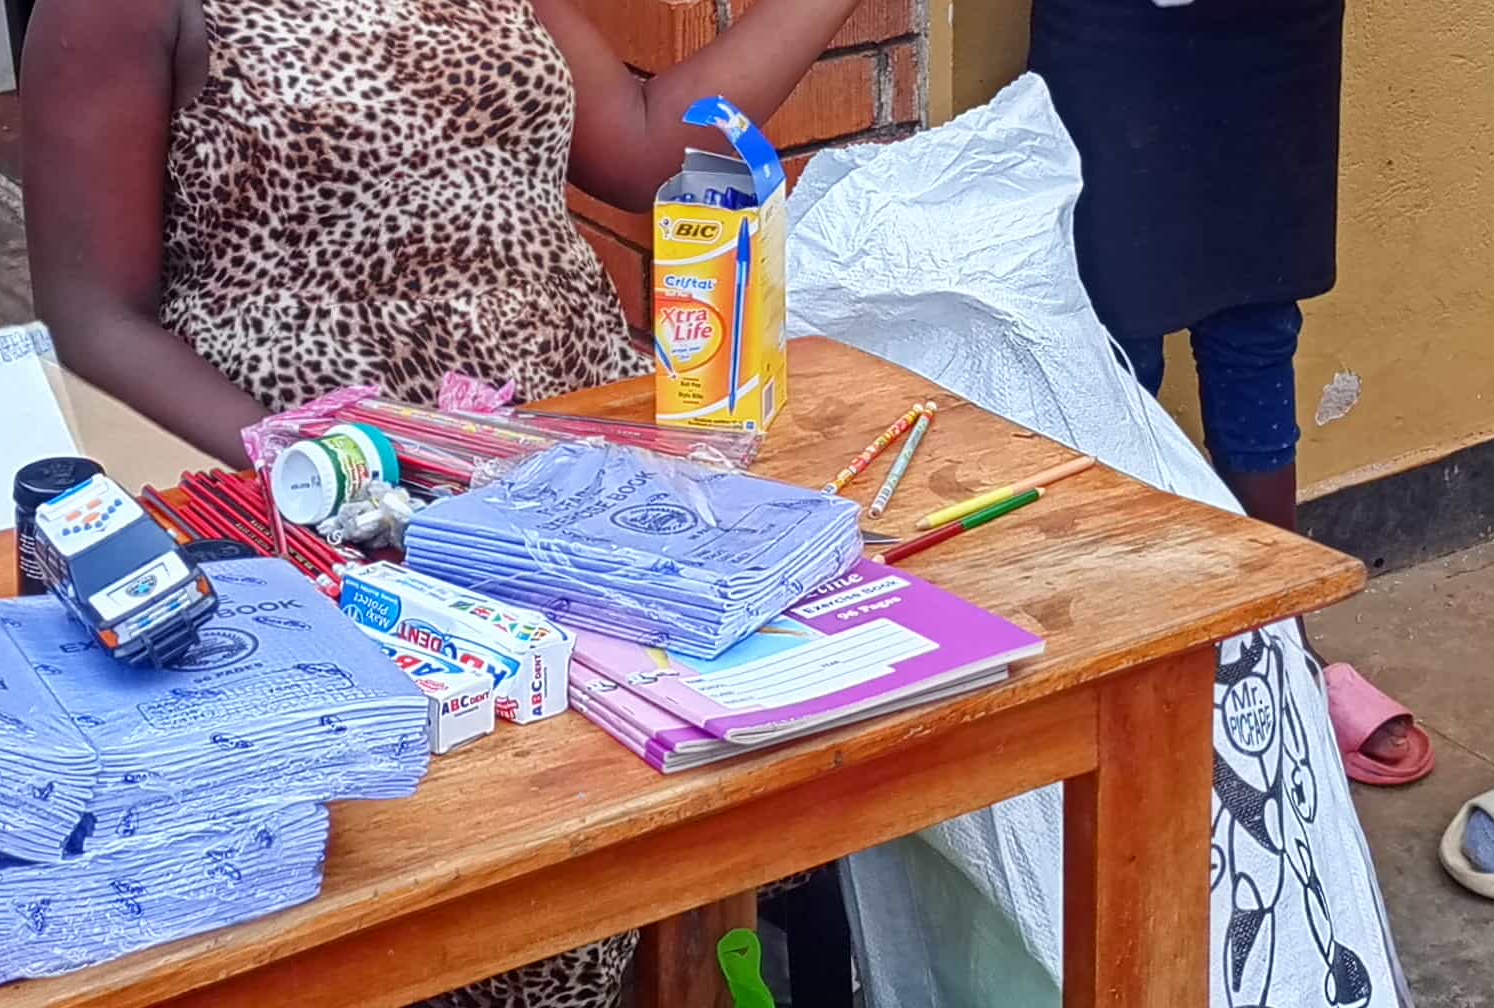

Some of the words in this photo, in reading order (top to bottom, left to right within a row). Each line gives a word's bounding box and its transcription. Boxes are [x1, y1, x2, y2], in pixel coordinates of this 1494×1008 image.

[661, 307, 708, 325] Xtra
[674, 323, 713, 341] Life
[606, 469, 657, 502] BOOK
[216, 597, 307, 619] BOOK
[352, 589, 389, 615] Protect
[802, 591, 861, 613] Exercise
[861, 579, 898, 594] Book
[857, 595, 903, 612] Pages
[398, 621, 443, 654] DENT
[1231, 681, 1264, 713] Mr.
[1230, 703, 1271, 747] PICFARE
